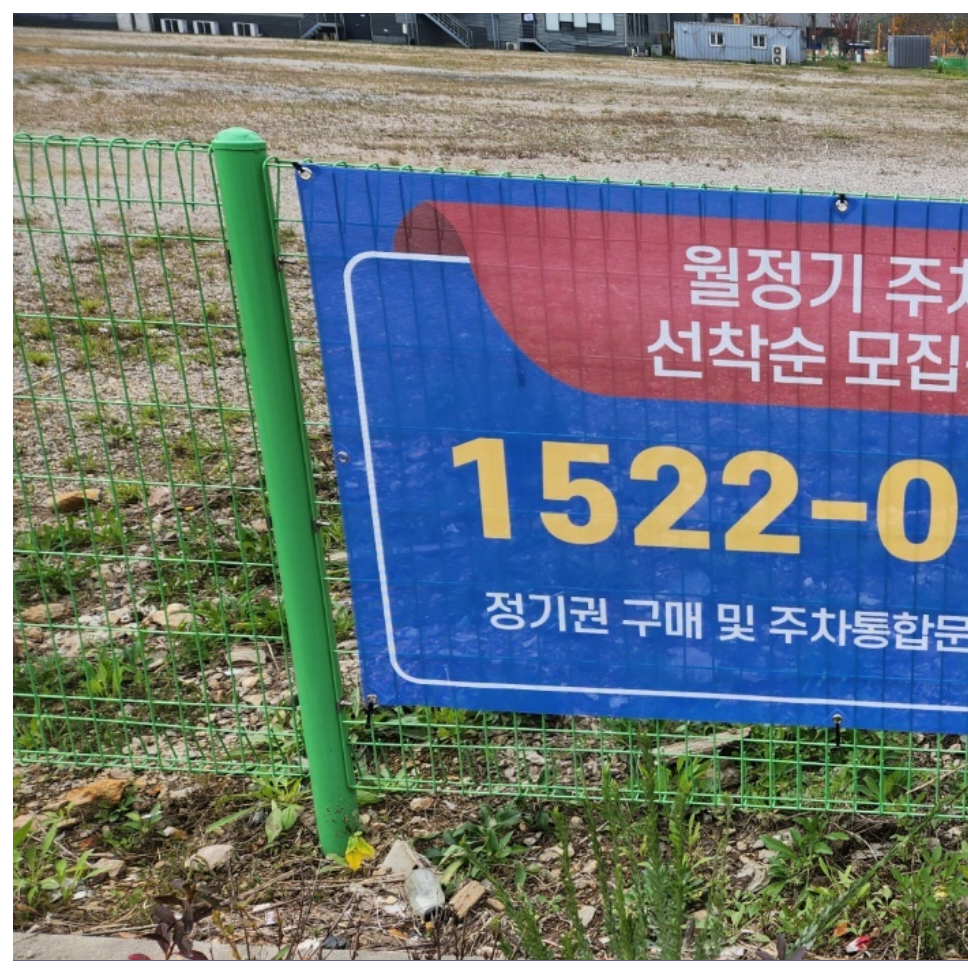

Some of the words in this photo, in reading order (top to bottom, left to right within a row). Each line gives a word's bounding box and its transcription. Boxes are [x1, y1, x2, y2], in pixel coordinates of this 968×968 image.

[683, 244, 863, 314] 월정기
[646, 319, 827, 385] 선착순
[485, 591, 609, 635] 정기권
[622, 598, 702, 640] 구매
[717, 603, 756, 643] 및
